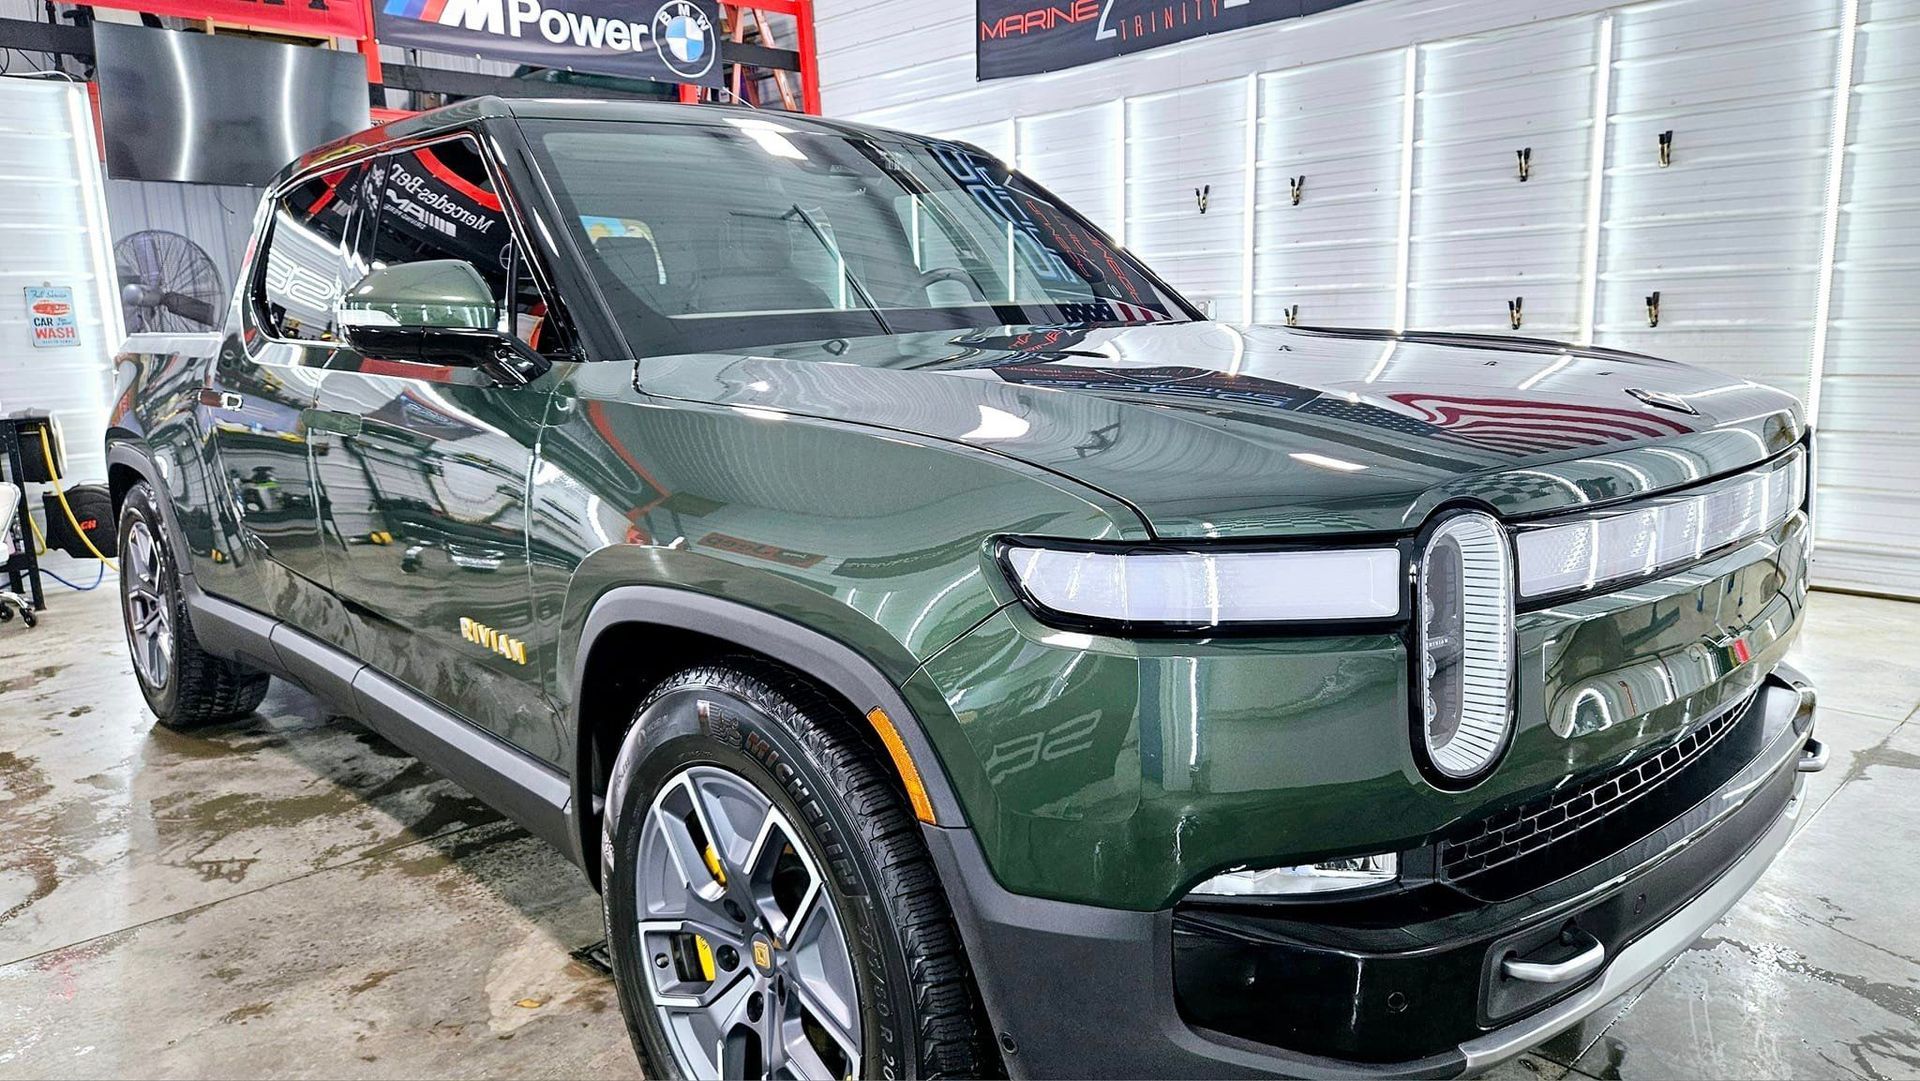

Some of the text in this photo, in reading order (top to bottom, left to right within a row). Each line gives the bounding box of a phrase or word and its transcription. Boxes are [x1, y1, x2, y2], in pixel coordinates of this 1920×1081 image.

[658, 3, 711, 32] BMW
[981, 0, 1099, 41] MARINE
[1120, 0, 1219, 41] TRINITY
[33, 317, 54, 327] CAR
[35, 327, 76, 340] WASH
[459, 616, 527, 666] RIVIAN
[746, 731, 859, 886] MICHELIN
